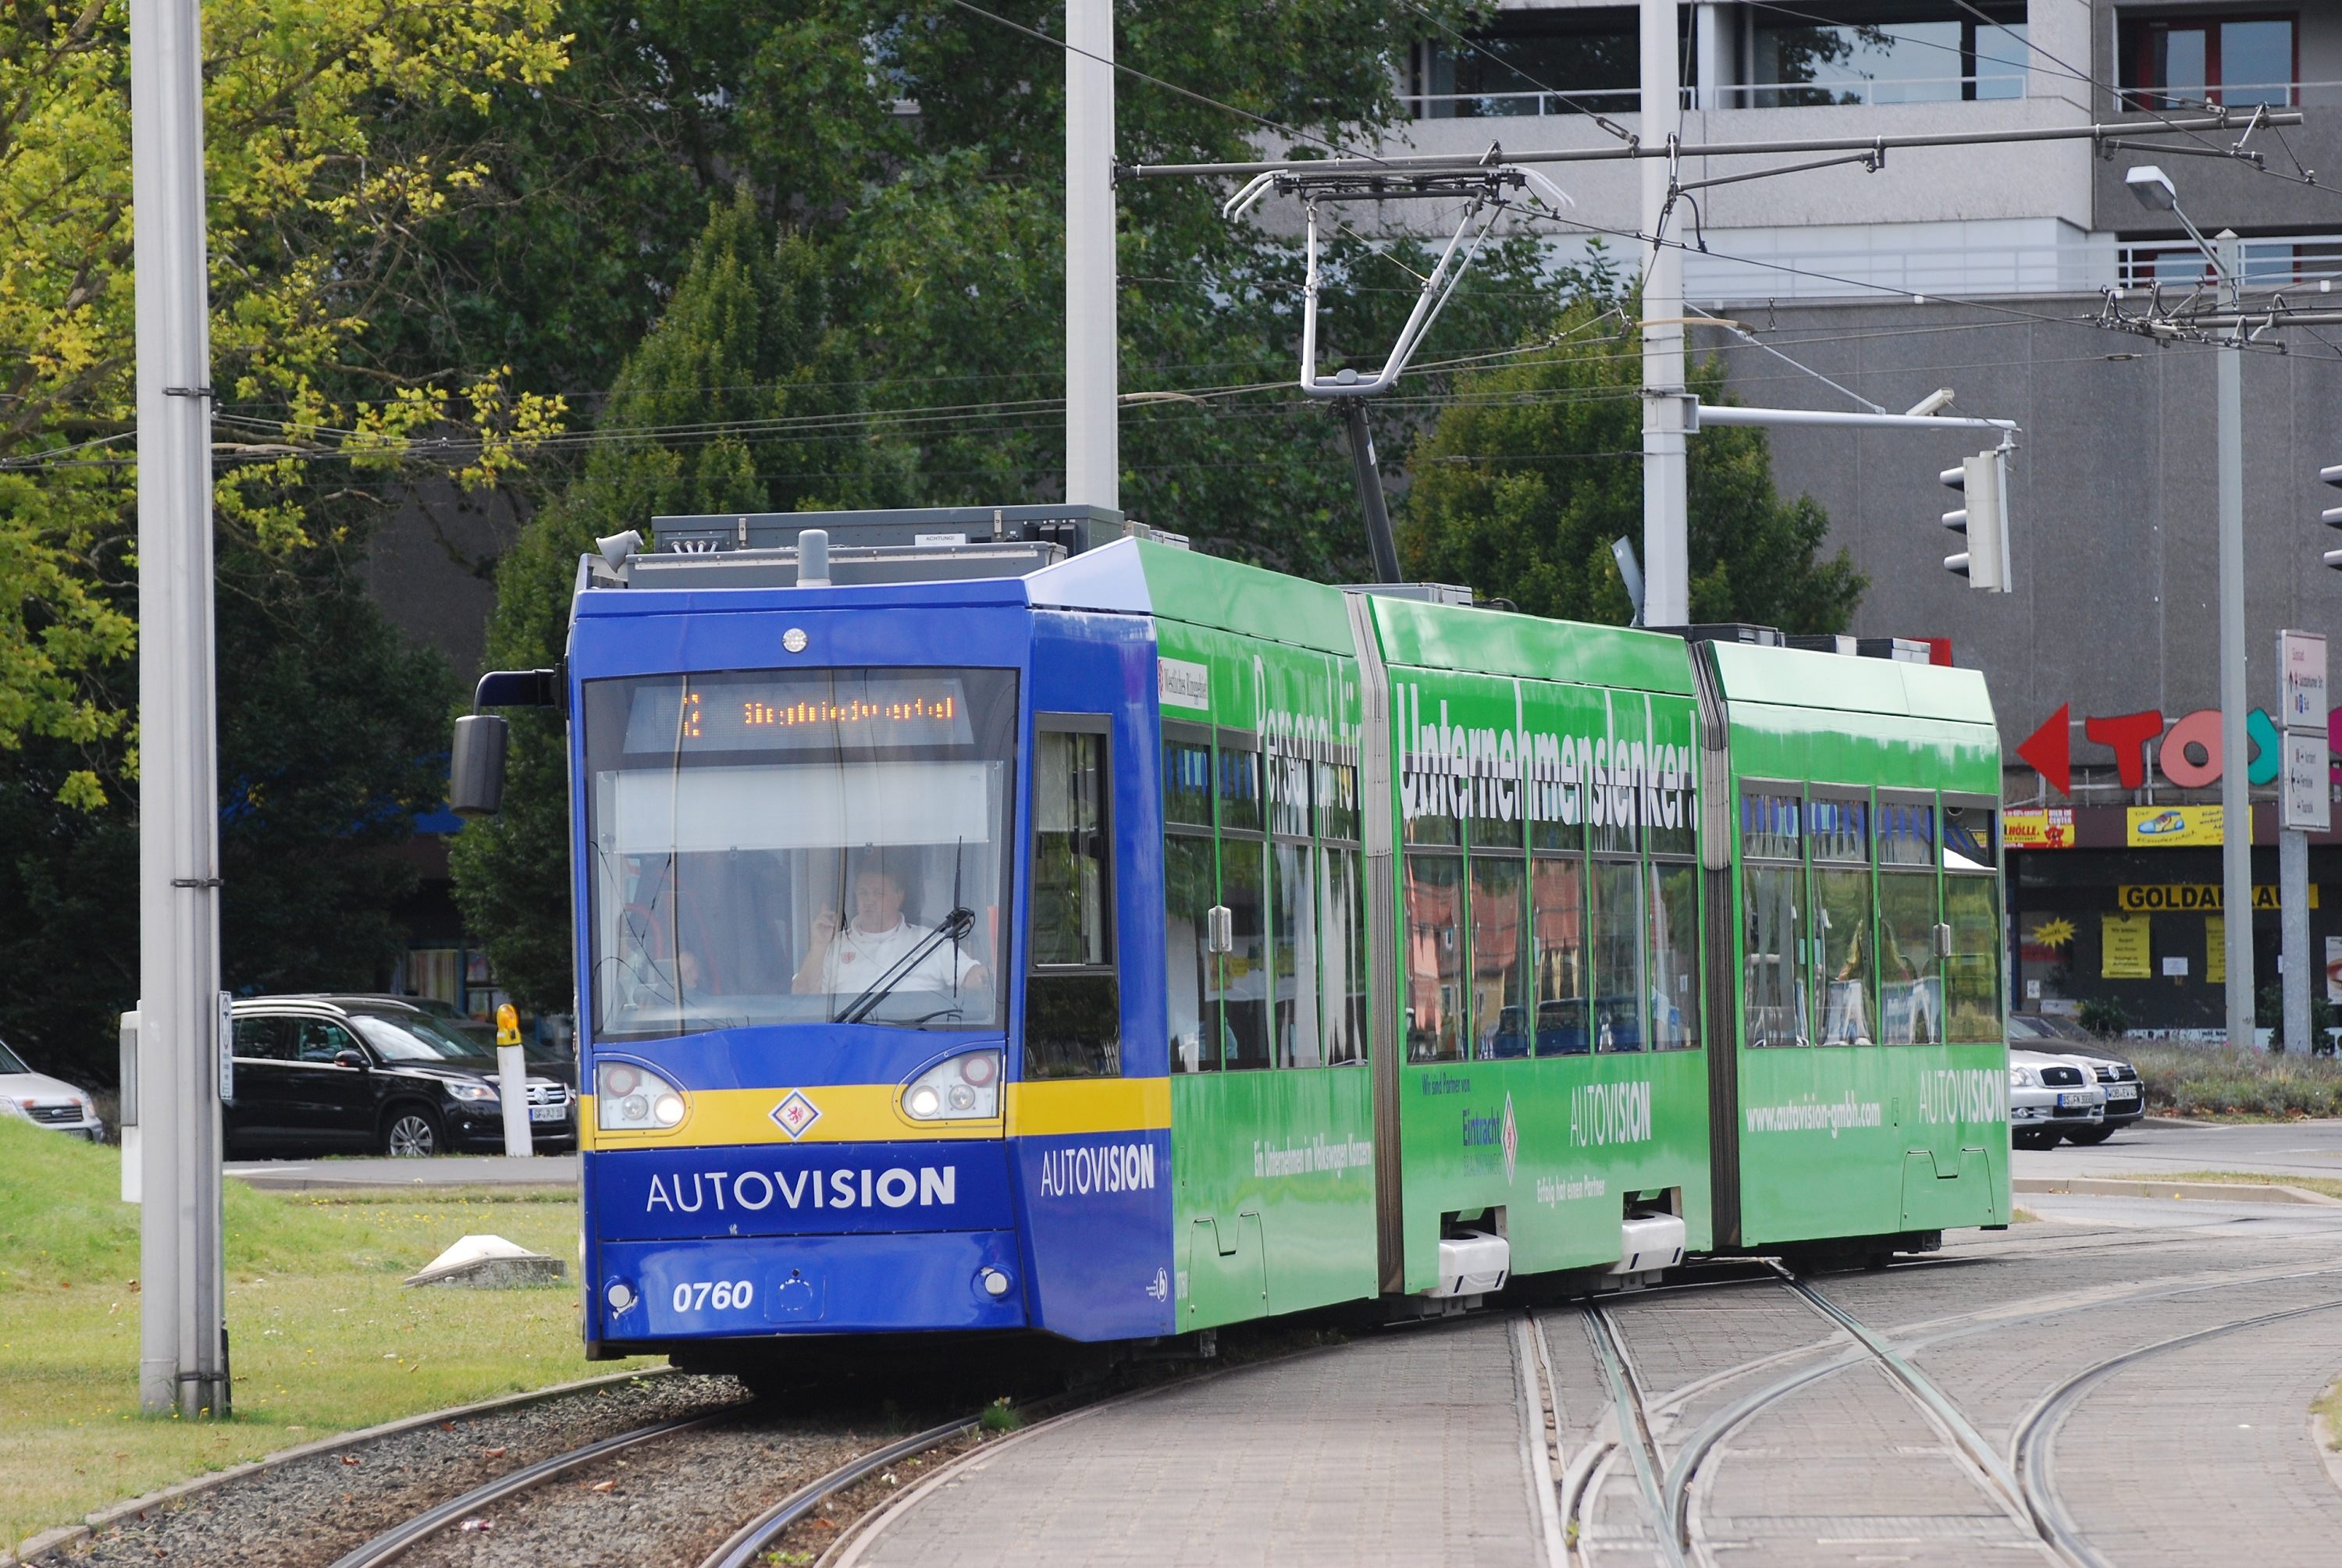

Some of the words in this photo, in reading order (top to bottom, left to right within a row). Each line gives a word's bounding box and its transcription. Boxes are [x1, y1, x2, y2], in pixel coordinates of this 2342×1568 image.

[1254, 654, 1333, 807] Personal
[1570, 1082, 1651, 1147] AUTOVISION
[1746, 1090, 1880, 1139] www.autovision-gmbh.com
[1919, 1068, 2005, 1125] AUTOVISION
[1462, 1106, 1500, 1147] Eintracht
[1040, 1144, 1155, 1196] AUTOVISION
[1312, 1132, 1347, 1179] Volkswagen
[646, 1166, 956, 1213] AUTOVISION
[1537, 1175, 1554, 1209] Erfolg
[1583, 1174, 1605, 1197] Partner
[673, 1280, 753, 1313] 0760
